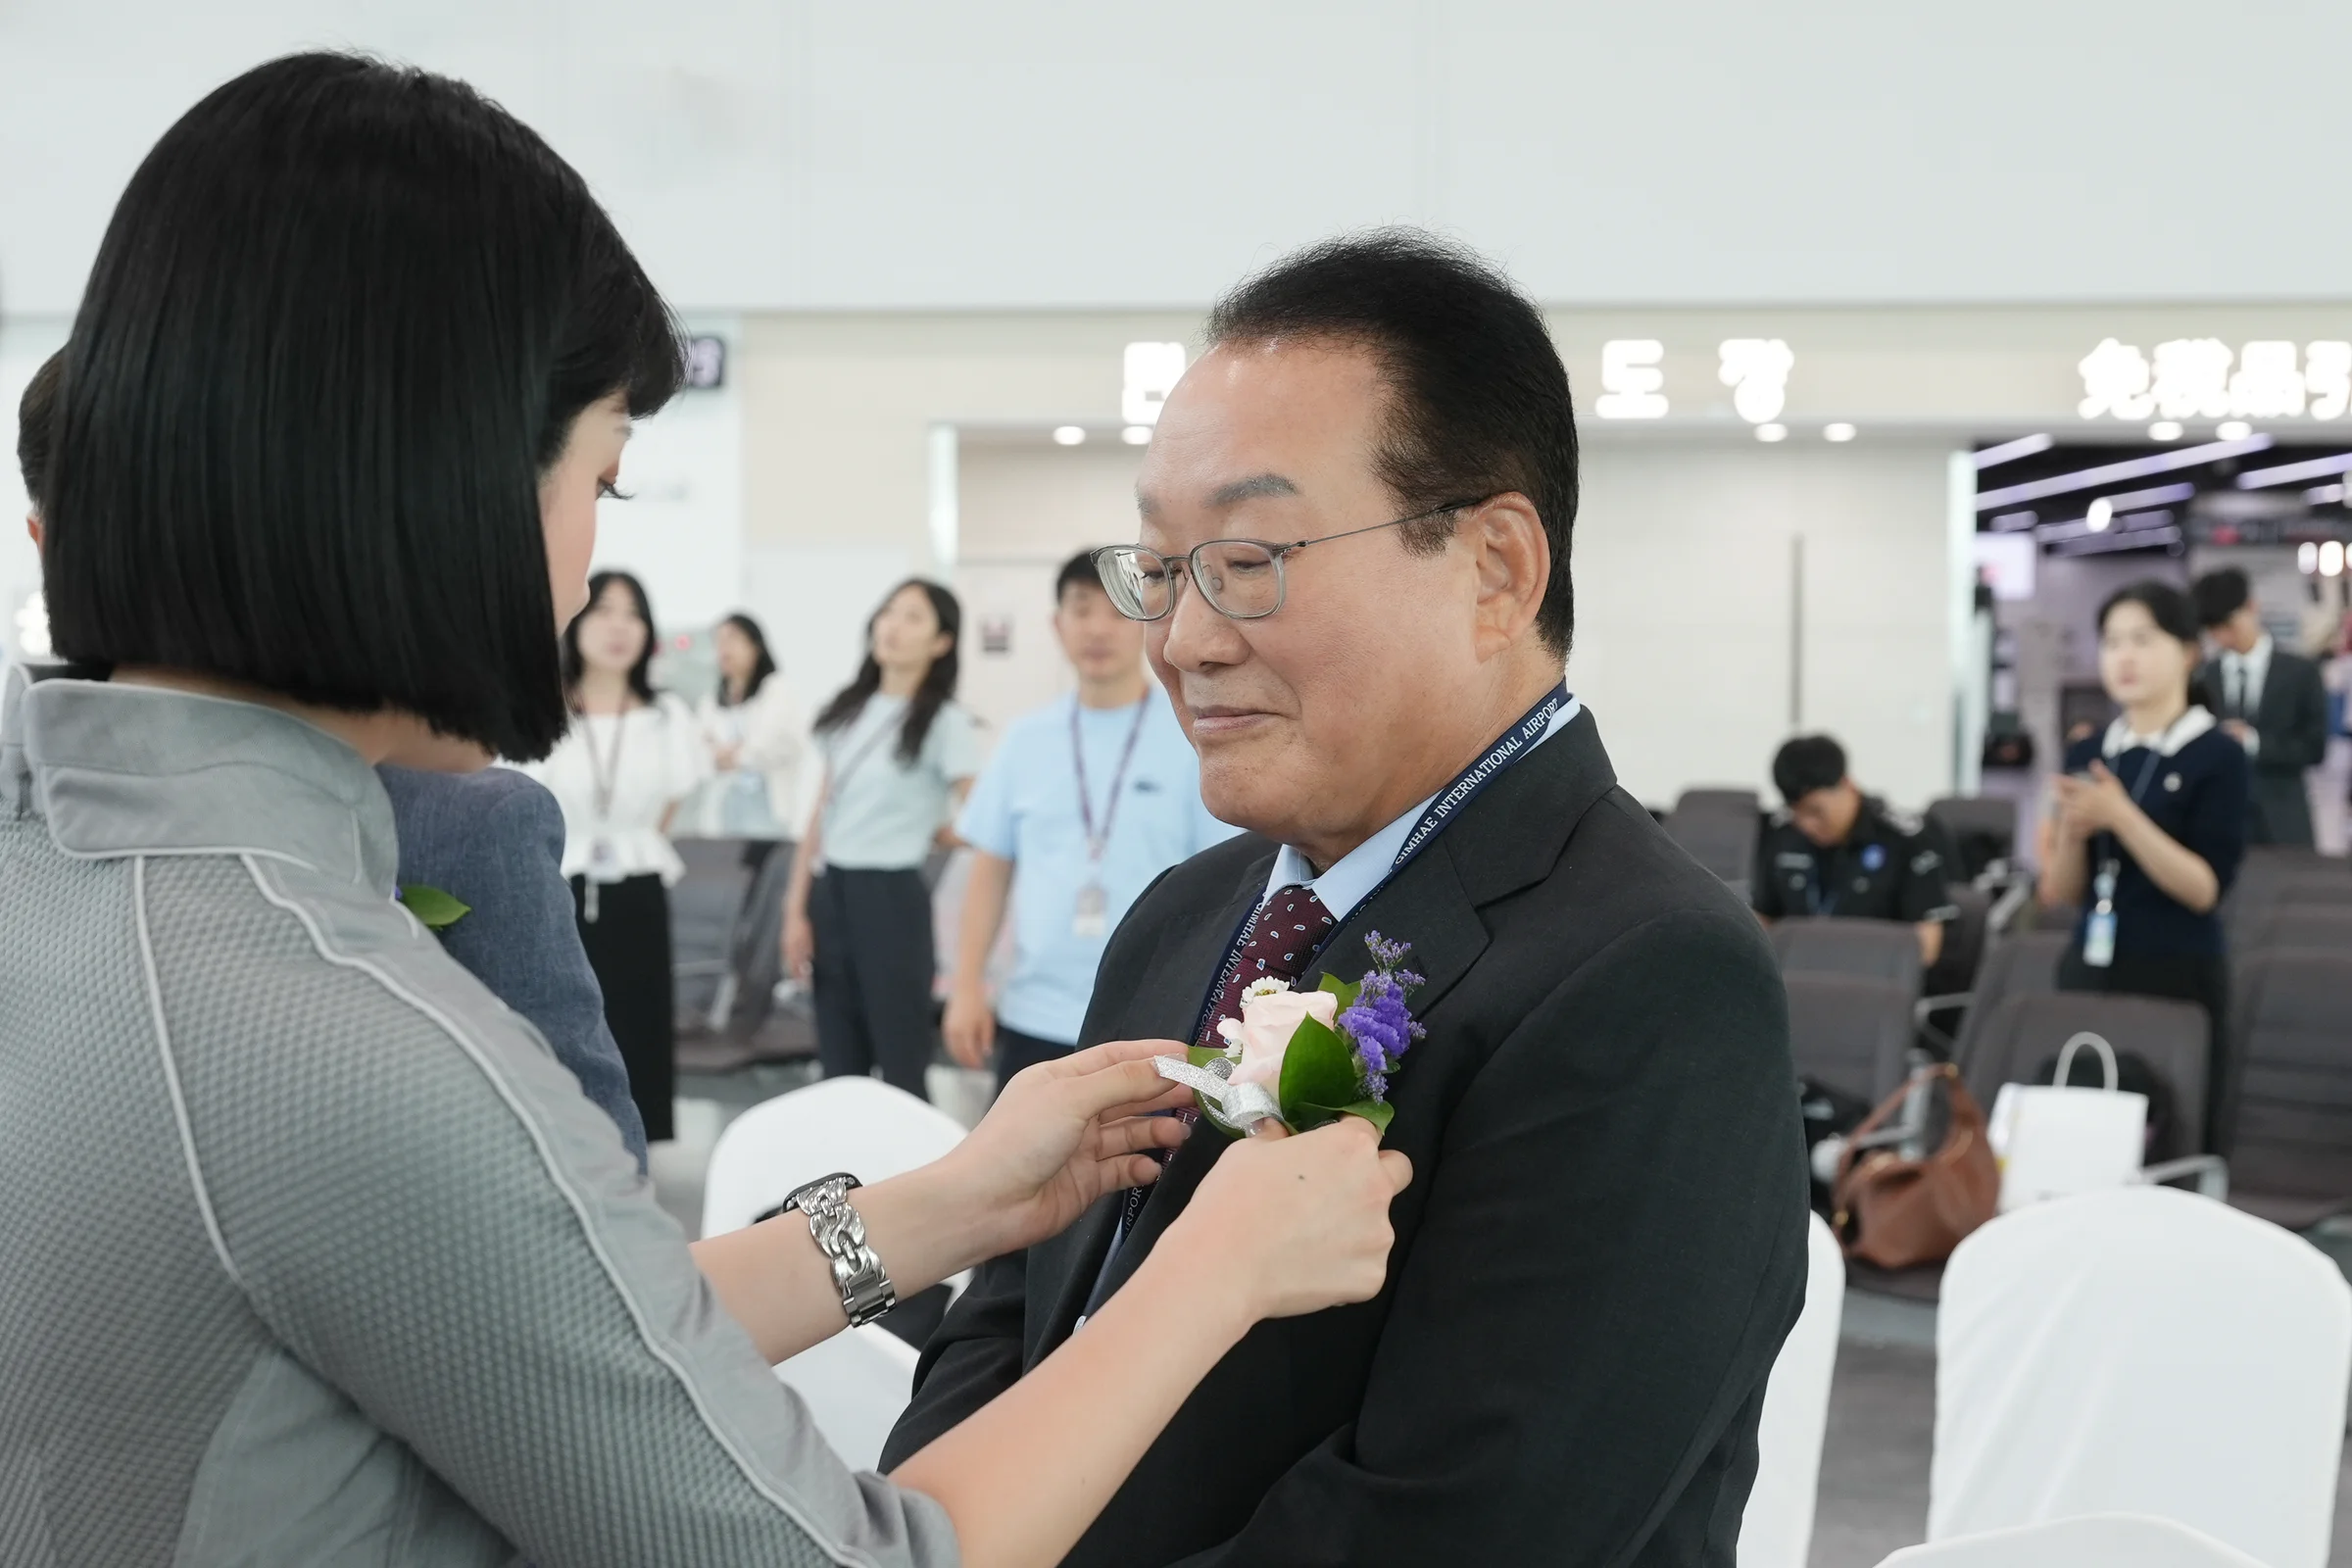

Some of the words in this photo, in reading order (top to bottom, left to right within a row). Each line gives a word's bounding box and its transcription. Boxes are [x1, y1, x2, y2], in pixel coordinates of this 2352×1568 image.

[1395, 815, 1438, 864] GIMHAE
[1434, 736, 1523, 818] INTERNATIONAL
[1522, 698, 1559, 740] AIRPORT
